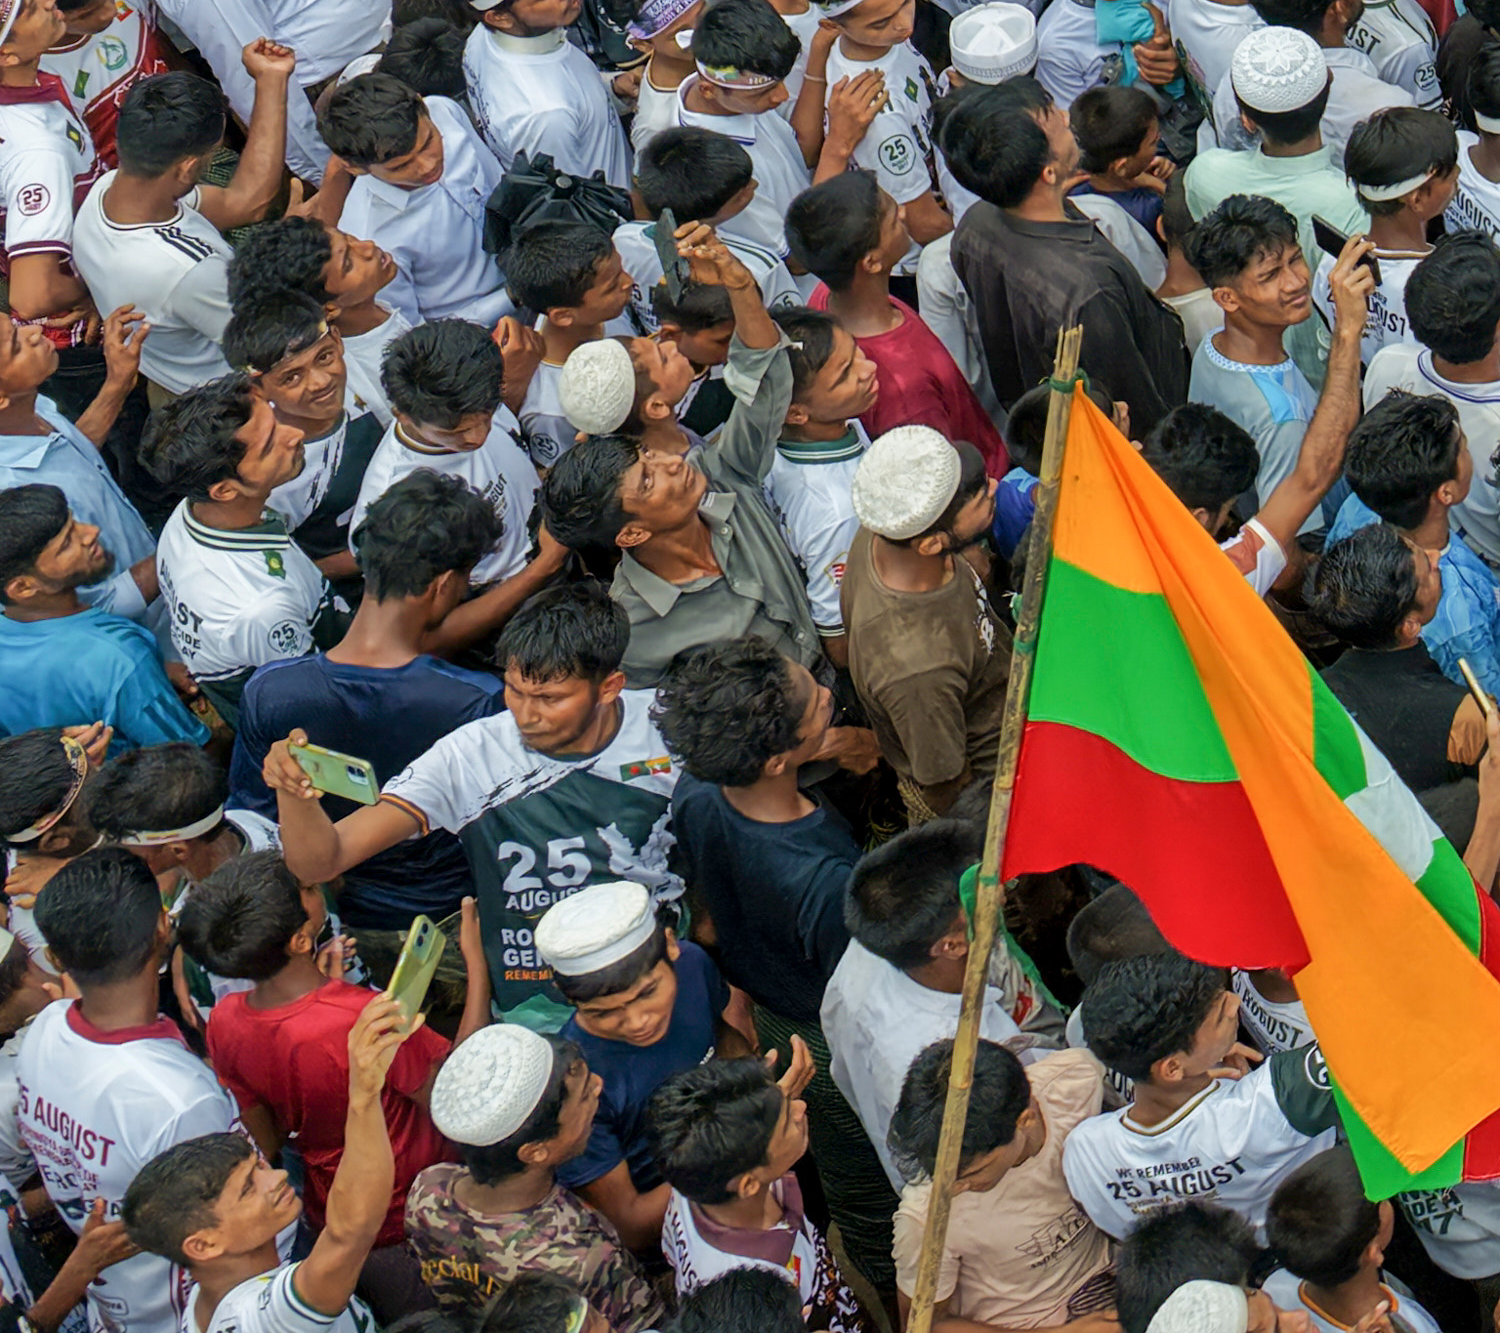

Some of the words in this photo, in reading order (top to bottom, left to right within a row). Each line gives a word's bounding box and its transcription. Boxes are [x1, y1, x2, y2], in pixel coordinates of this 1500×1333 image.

[497, 835, 595, 890] 25
[1106, 1179, 1141, 1200] 25
[1148, 1156, 1246, 1197] AUGUST
[1135, 1156, 1202, 1179] REMEMBER
